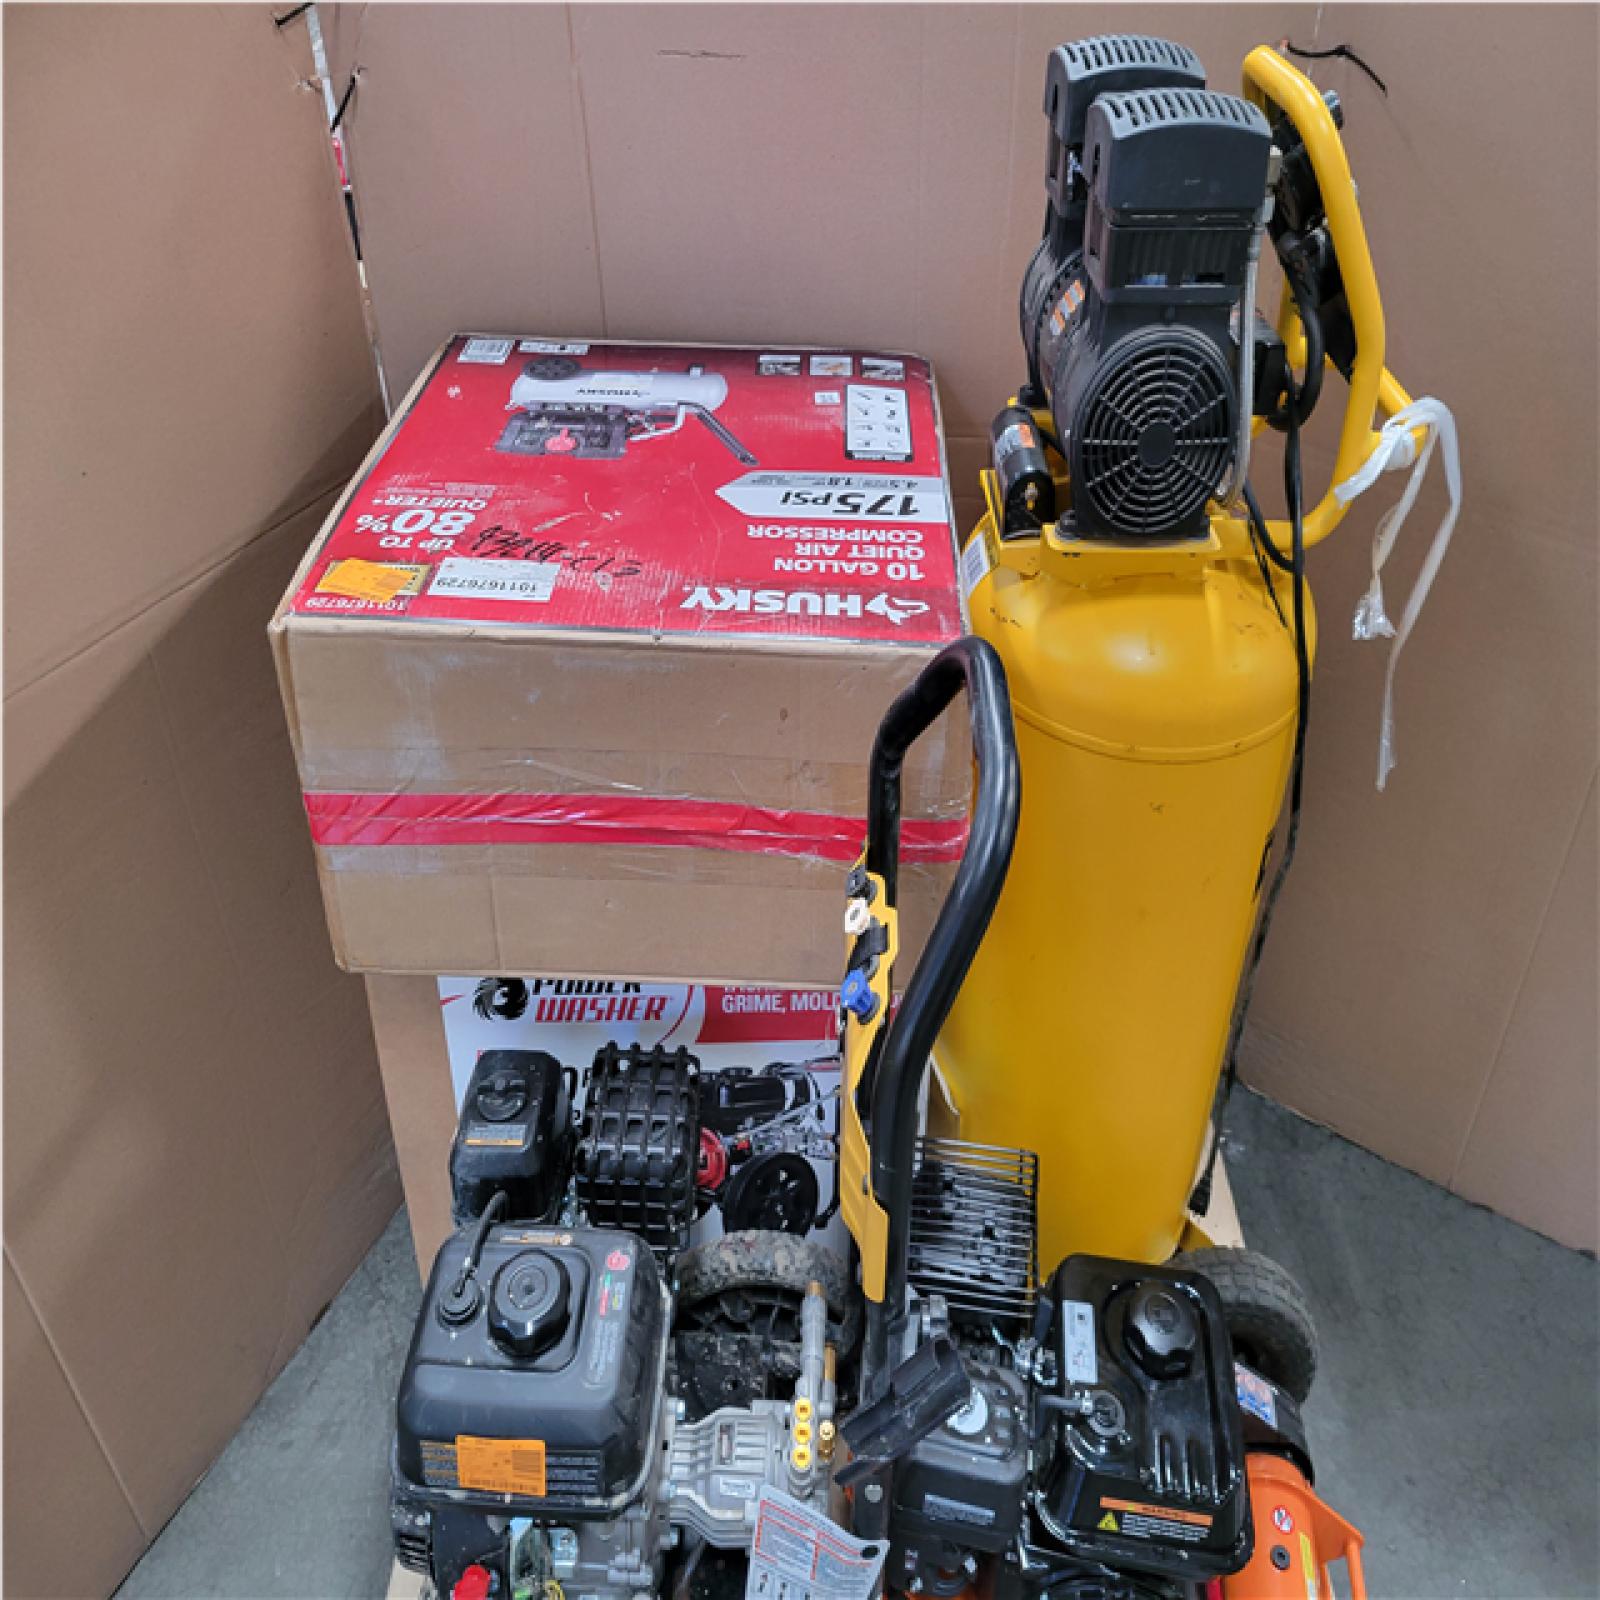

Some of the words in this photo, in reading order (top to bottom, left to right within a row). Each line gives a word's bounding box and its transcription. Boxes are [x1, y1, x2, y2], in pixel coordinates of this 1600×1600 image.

[780, 490, 834, 506] PSI
[832, 493, 921, 516] 175
[380, 534, 413, 548] TO
[418, 536, 455, 549] UP
[747, 524, 924, 543] COMPRESSOR
[795, 542, 841, 556] AIR
[847, 543, 926, 561] QUIET
[774, 557, 880, 576] GALLON
[886, 562, 926, 581] 10
[680, 586, 864, 618] HUSKY
[534, 996, 669, 1022] WASHER
[721, 994, 786, 1015] GRIME,
